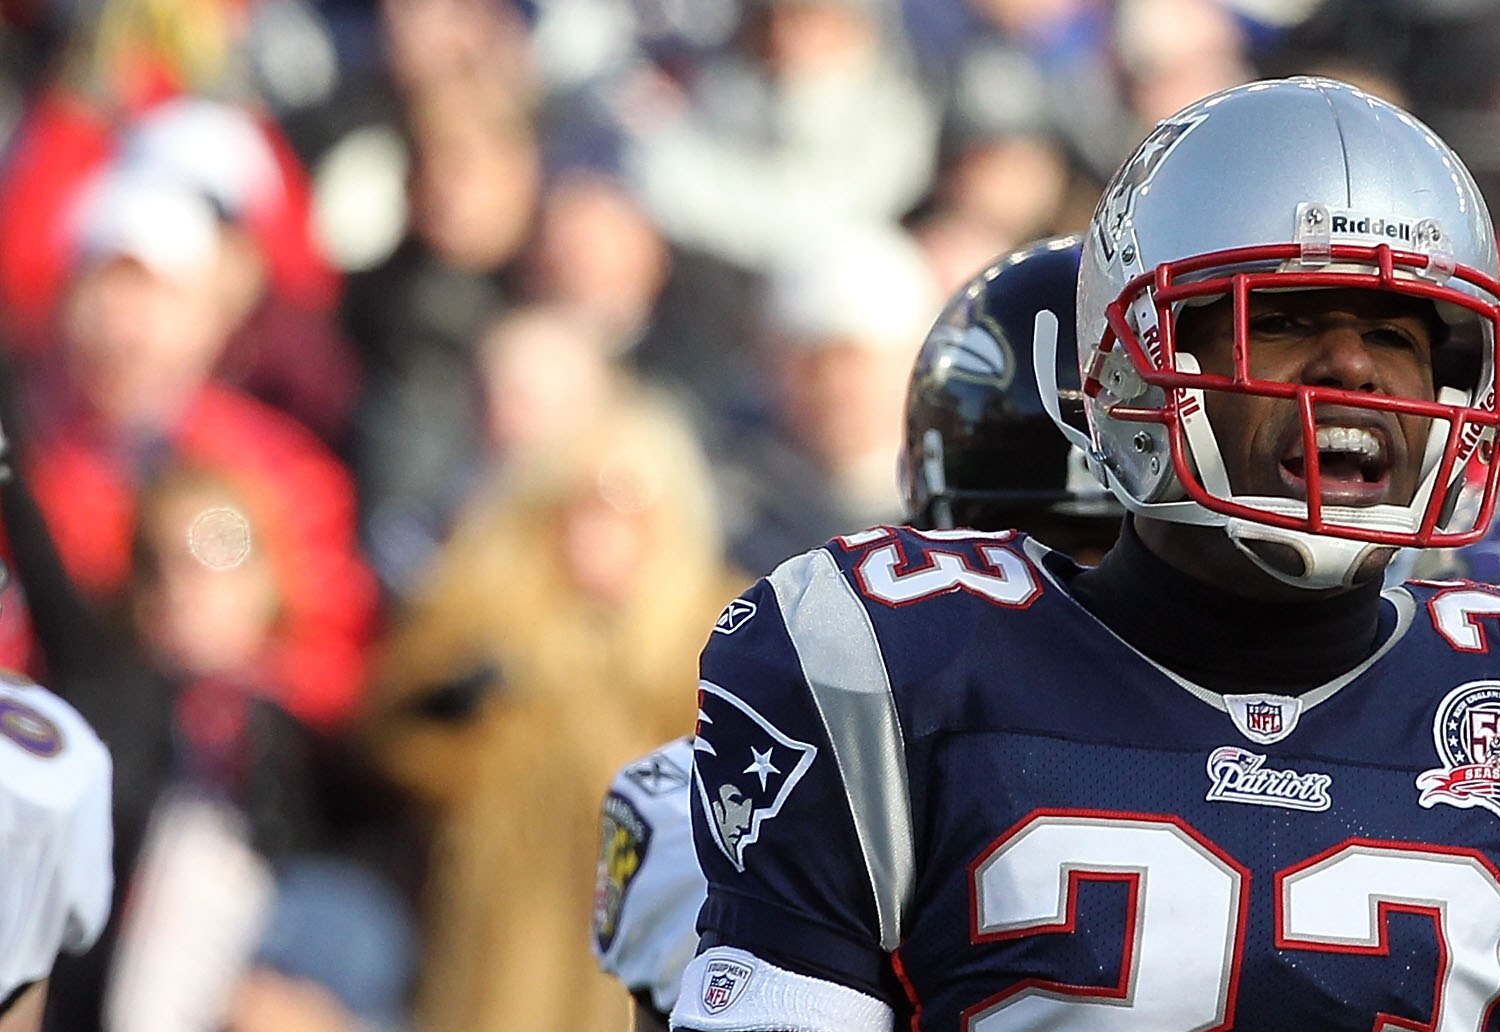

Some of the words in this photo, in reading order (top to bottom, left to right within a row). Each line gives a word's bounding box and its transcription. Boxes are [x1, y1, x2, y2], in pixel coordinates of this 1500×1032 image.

[1331, 215, 1411, 242] Riddell
[1452, 699, 1468, 719] NEW
[1249, 713, 1281, 733] NFL
[1210, 760, 1331, 806] Patriots
[707, 962, 749, 980] EQUIPMENT
[705, 986, 728, 1005] NFL
